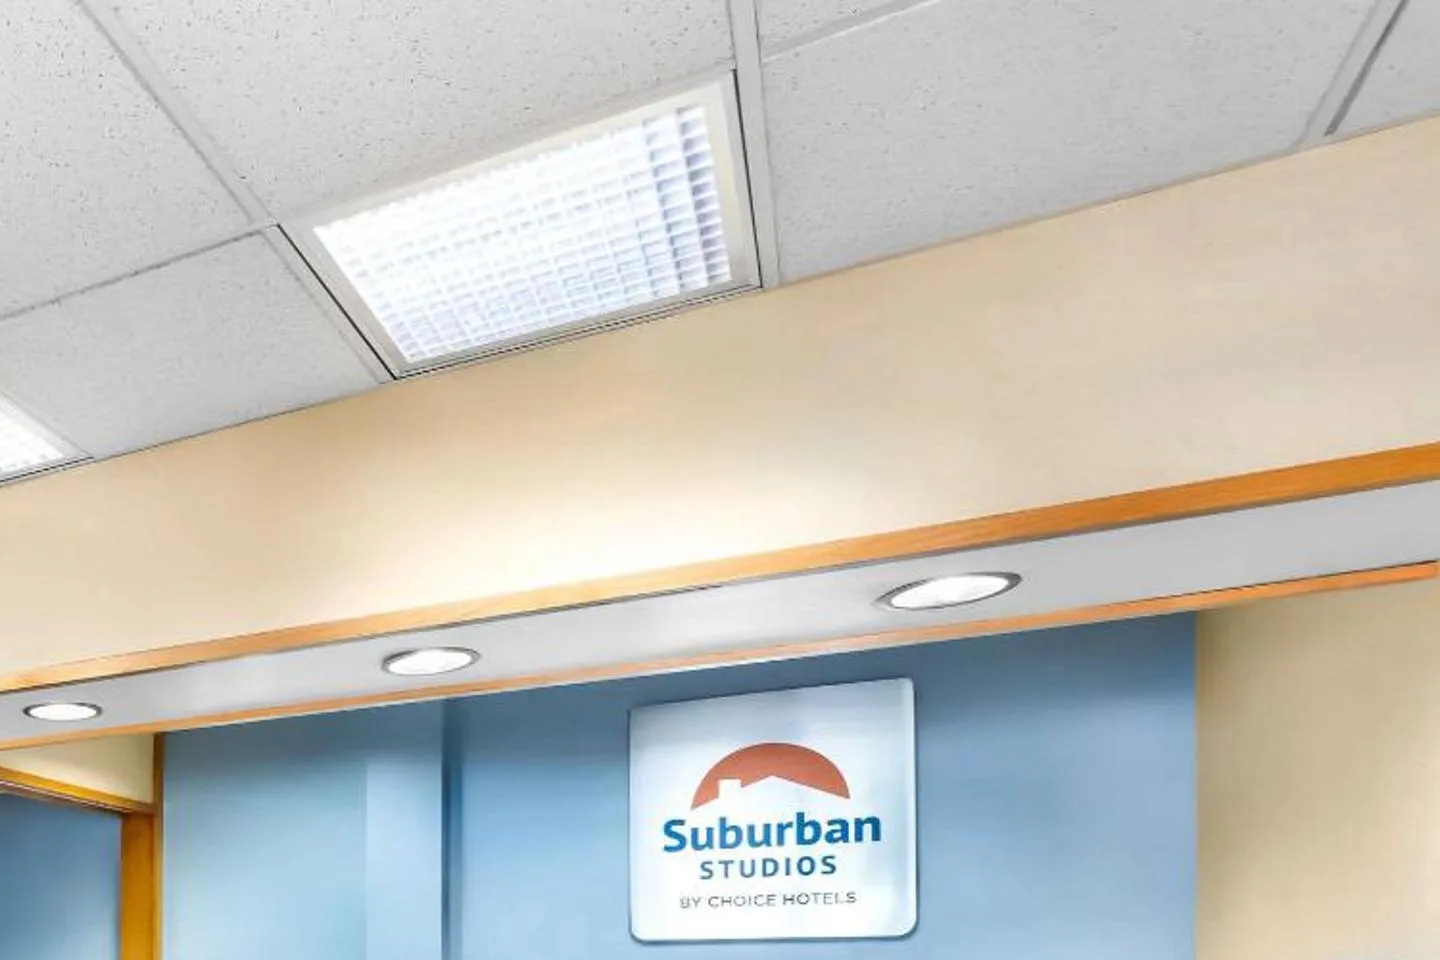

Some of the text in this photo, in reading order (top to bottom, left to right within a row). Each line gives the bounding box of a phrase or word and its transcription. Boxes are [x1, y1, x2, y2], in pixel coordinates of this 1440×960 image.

[662, 812, 882, 853] Suburban
[699, 855, 837, 880] STUDIOS
[680, 891, 857, 909] BY CHOICE HOTELS
